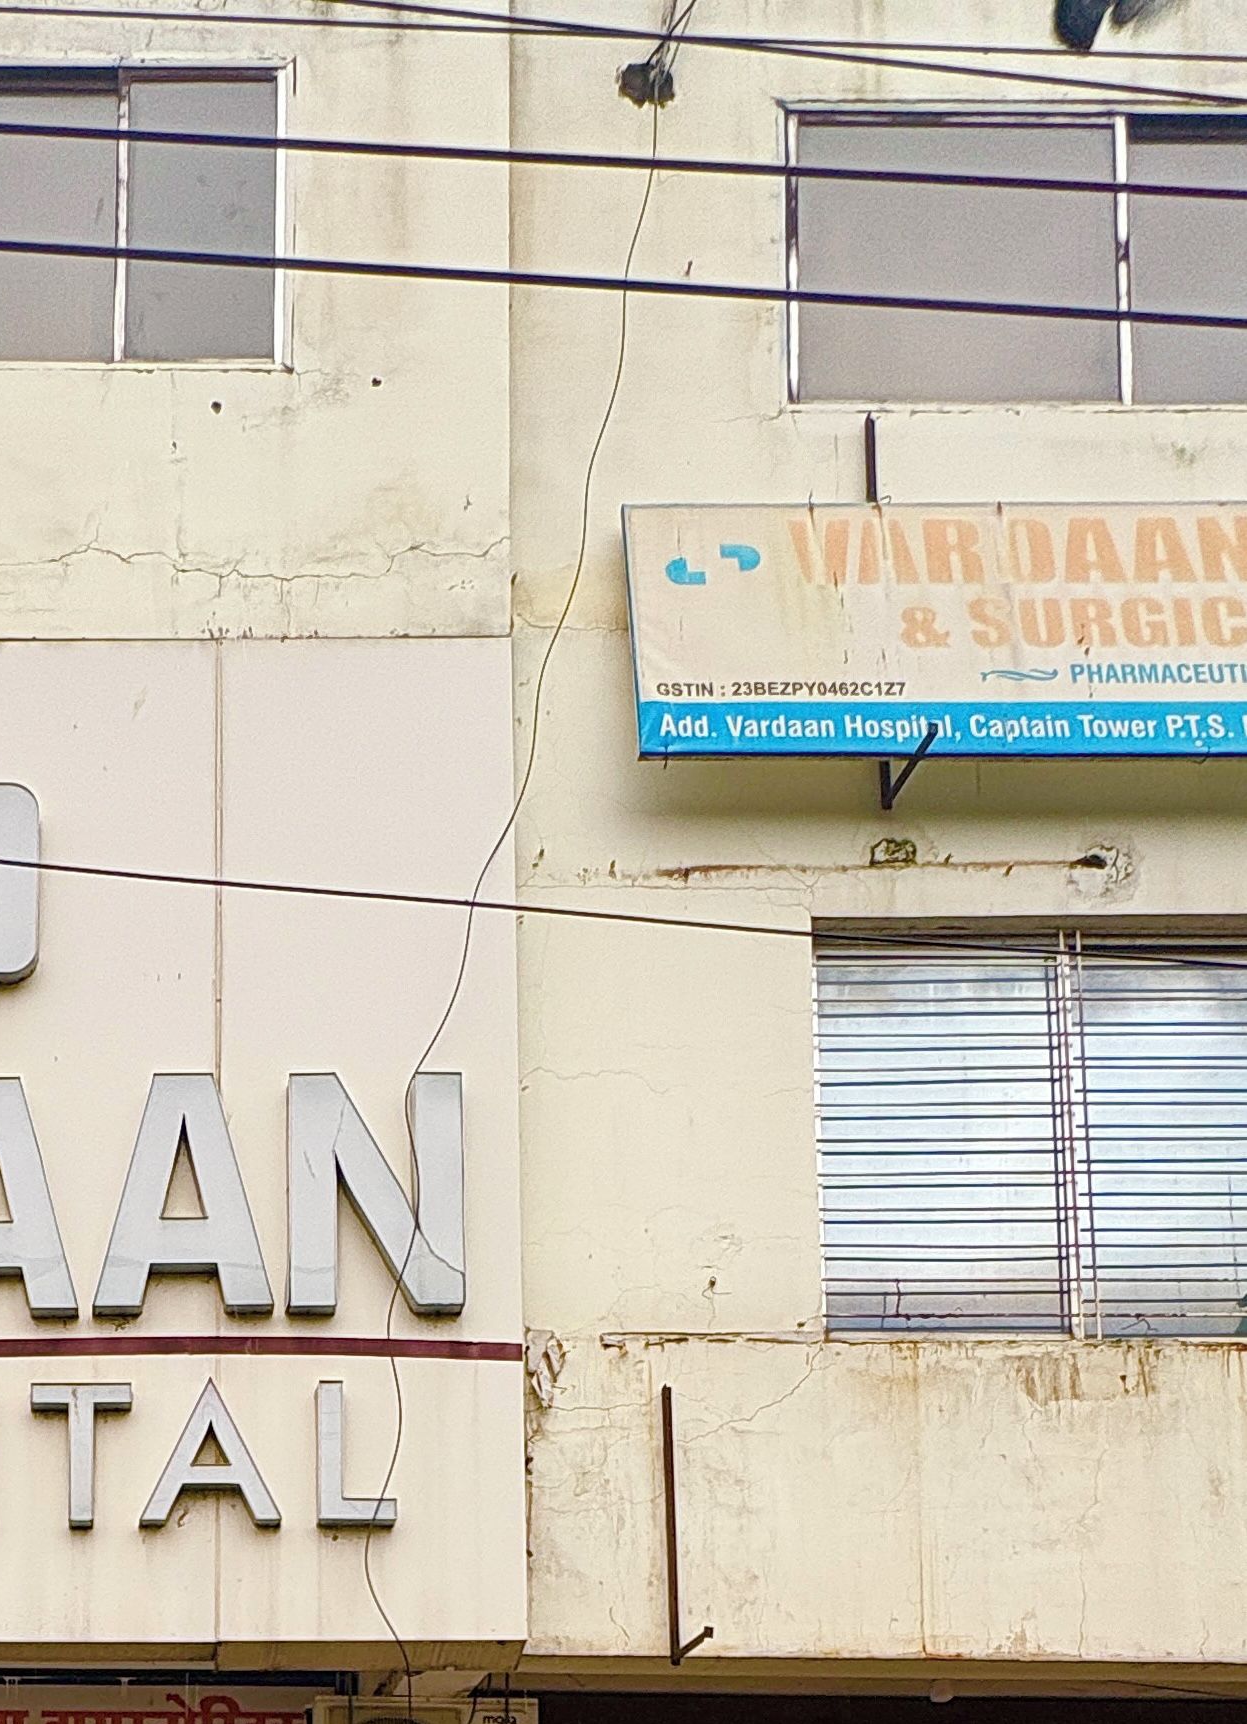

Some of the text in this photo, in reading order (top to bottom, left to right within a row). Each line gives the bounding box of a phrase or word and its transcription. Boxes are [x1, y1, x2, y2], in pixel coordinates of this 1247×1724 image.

[786, 516, 1247, 585] VARDAAN
[901, 606, 950, 648] &
[656, 681, 714, 697] GSTIN
[659, 713, 717, 737] Add.
[725, 714, 835, 738] Vardaan
[843, 714, 962, 743] Hospital,
[969, 714, 1071, 742] Captain
[1076, 714, 1157, 739] Tower
[1165, 714, 1235, 738] P.T.S.
